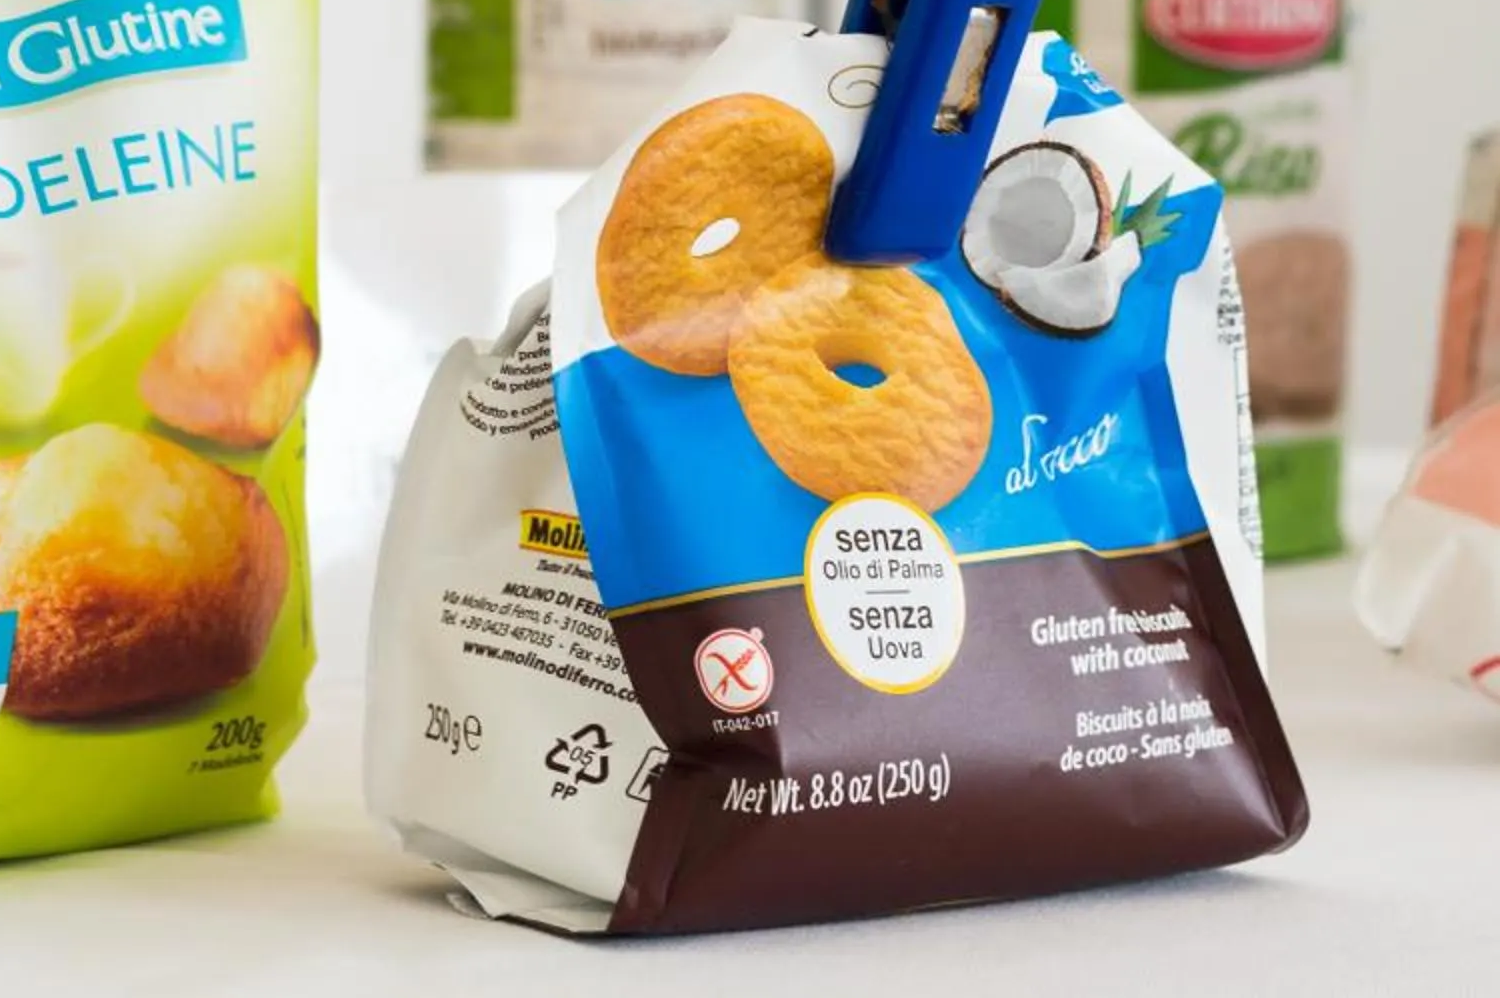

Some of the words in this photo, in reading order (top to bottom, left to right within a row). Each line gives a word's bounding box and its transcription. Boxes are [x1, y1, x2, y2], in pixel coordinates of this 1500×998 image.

[8, 1, 226, 85] Glutine
[491, 380, 506, 391] de
[511, 410, 518, 418] e
[835, 527, 923, 553] senza
[823, 560, 861, 580] Olio
[866, 559, 883, 579] di
[888, 559, 944, 579] Palma
[503, 582, 555, 603] MOLINO
[557, 592, 574, 608] DI
[461, 594, 496, 613] Molino
[500, 602, 511, 616] di
[543, 612, 553, 625] 6
[561, 616, 603, 642] 31050
[604, 629, 619, 647] Ve
[849, 605, 933, 630] senza
[1031, 615, 1105, 646] Gluten
[460, 615, 482, 631] +39
[568, 641, 591, 662] Fax
[594, 652, 621, 672] +39
[868, 636, 923, 659] Uova
[1071, 643, 1120, 676] with
[1123, 638, 1190, 668] coconut
[1076, 705, 1143, 737] Biscuits
[1146, 702, 1158, 727] à
[1161, 698, 1177, 724] la
[205, 714, 265, 753] 200g
[570, 747, 595, 766] 05
[1060, 745, 1083, 772] de
[1086, 743, 1127, 767] coco
[1140, 733, 1182, 759] Sans
[1184, 725, 1234, 759] gluten
[550, 780, 579, 801] PP
[723, 777, 766, 814] Net
[770, 777, 805, 816] Wt.
[809, 770, 844, 810] 8.8
[849, 773, 873, 804] oz
[877, 757, 925, 806] (250
[928, 752, 950, 802] g)
